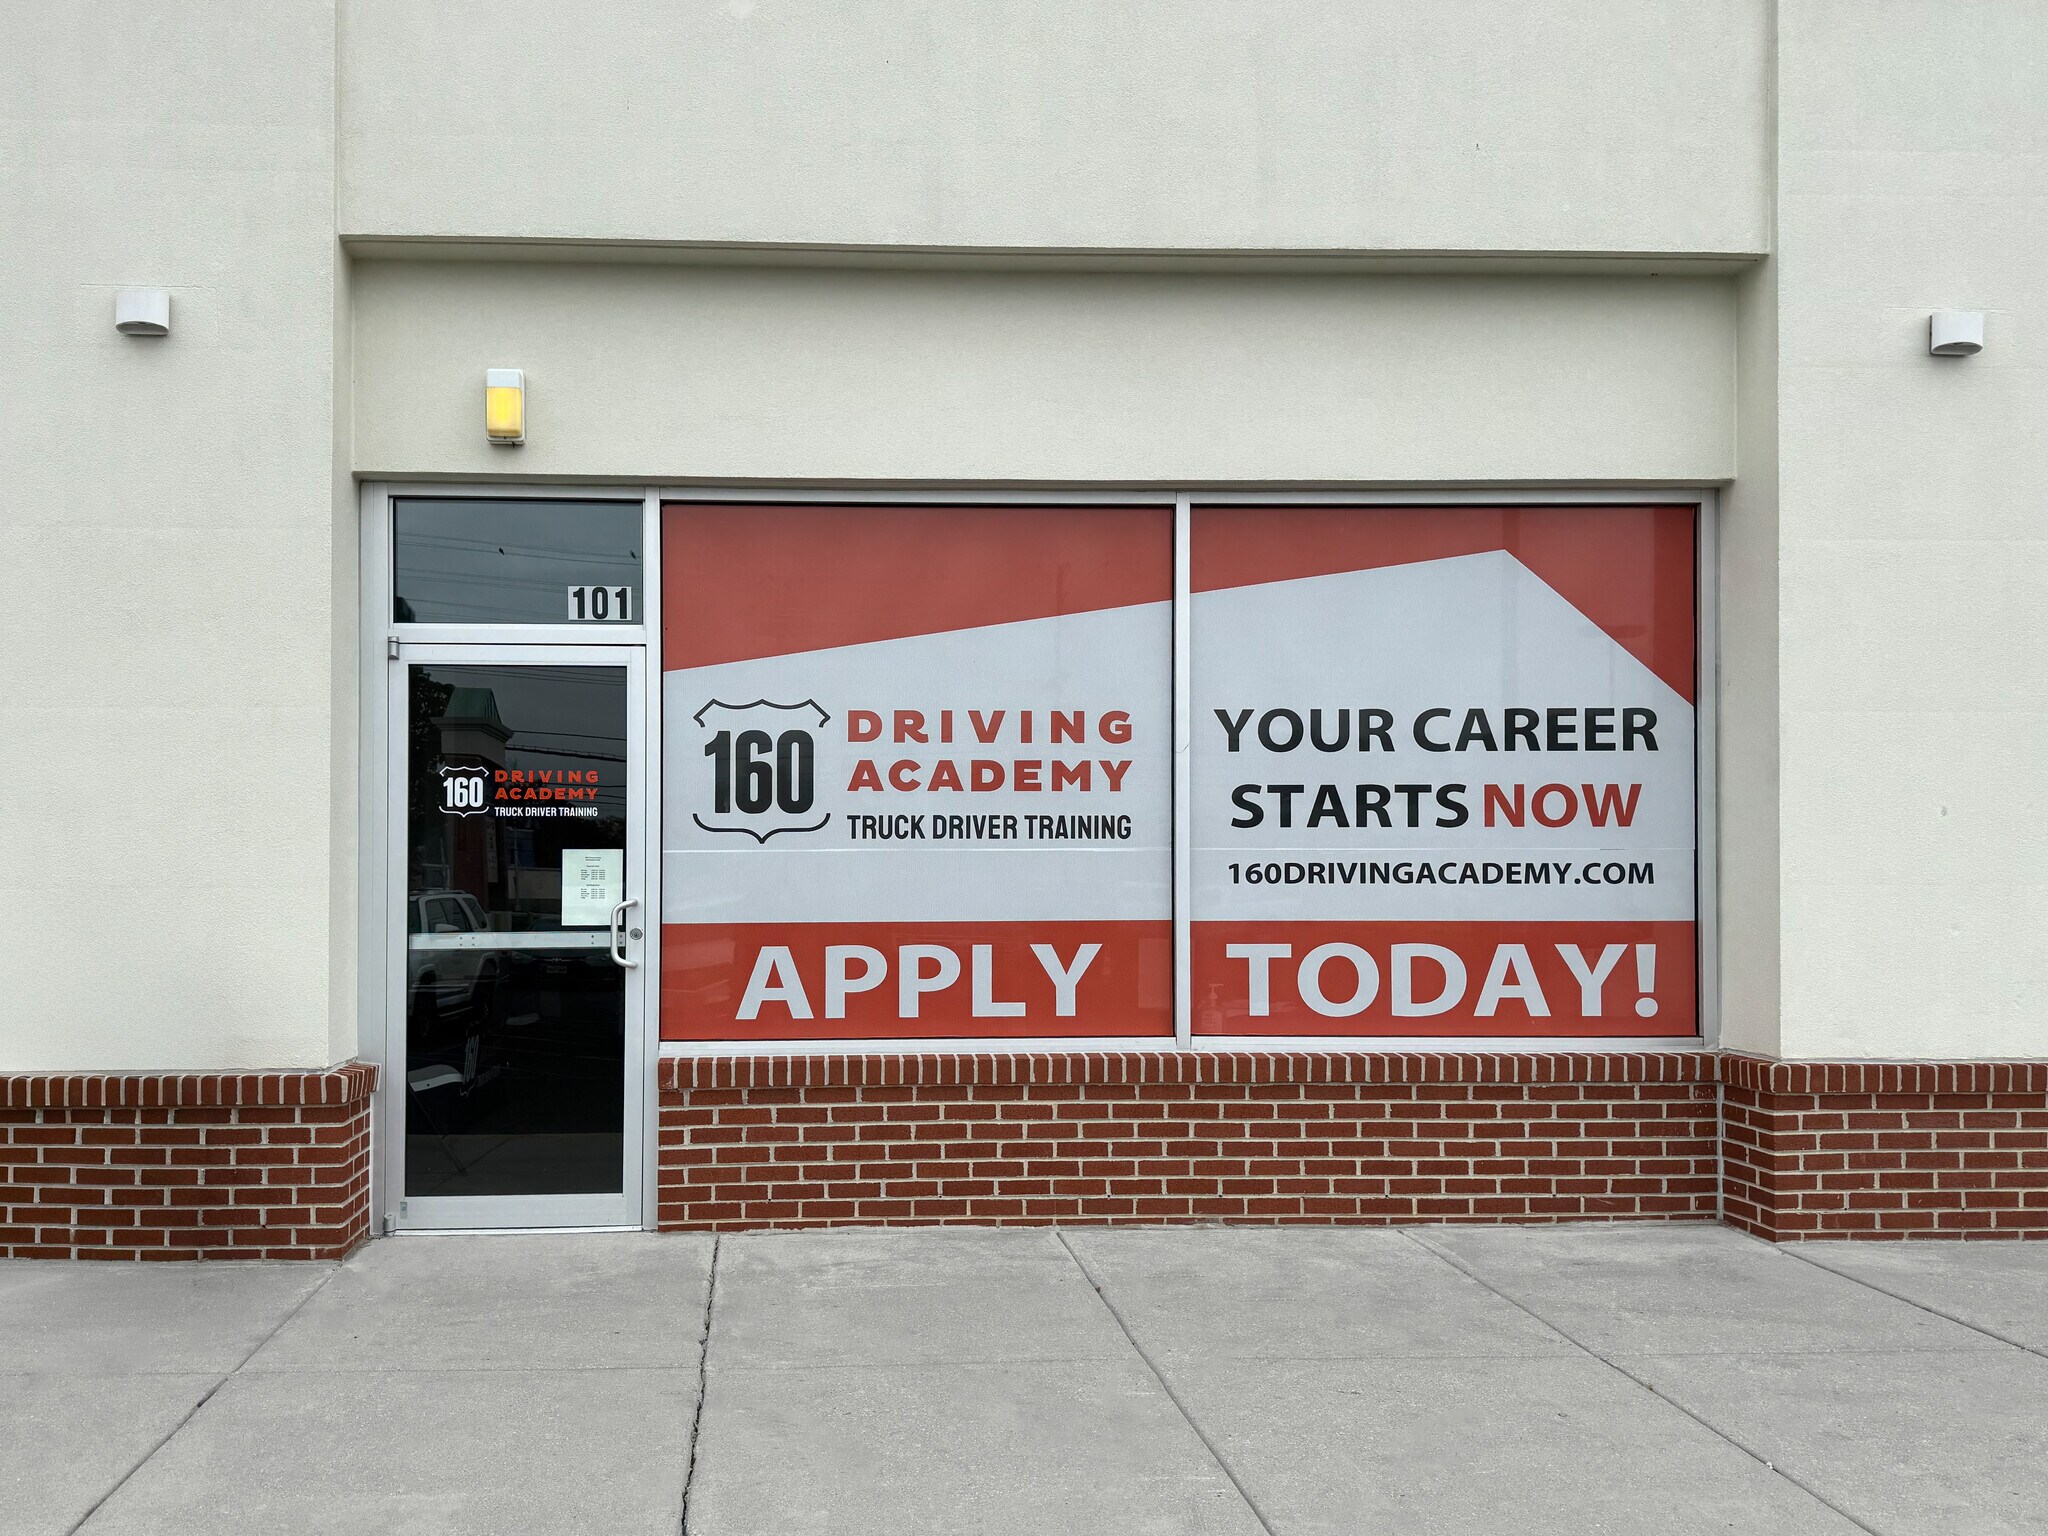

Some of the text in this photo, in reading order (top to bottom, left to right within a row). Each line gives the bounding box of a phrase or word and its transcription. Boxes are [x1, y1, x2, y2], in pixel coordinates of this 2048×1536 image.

[572, 586, 628, 620] 101
[846, 709, 1133, 744] DRIVING
[1214, 707, 1659, 753] YOUR CAREER
[494, 769, 599, 783] DRIVING
[704, 729, 815, 814] 160
[846, 759, 1133, 792] ACADEMY
[443, 776, 484, 808] 160
[494, 787, 599, 800] ACADEMY
[1230, 782, 1643, 829] STARTS NOW
[494, 806, 598, 817] TRUCK DRIVER TRAINING
[846, 814, 1132, 840] TRUCK DRIVER TRAINING
[1228, 861, 1655, 885] 160DRIVINGACADEMY.COM
[735, 941, 1659, 1020] APPLY TODAY!
